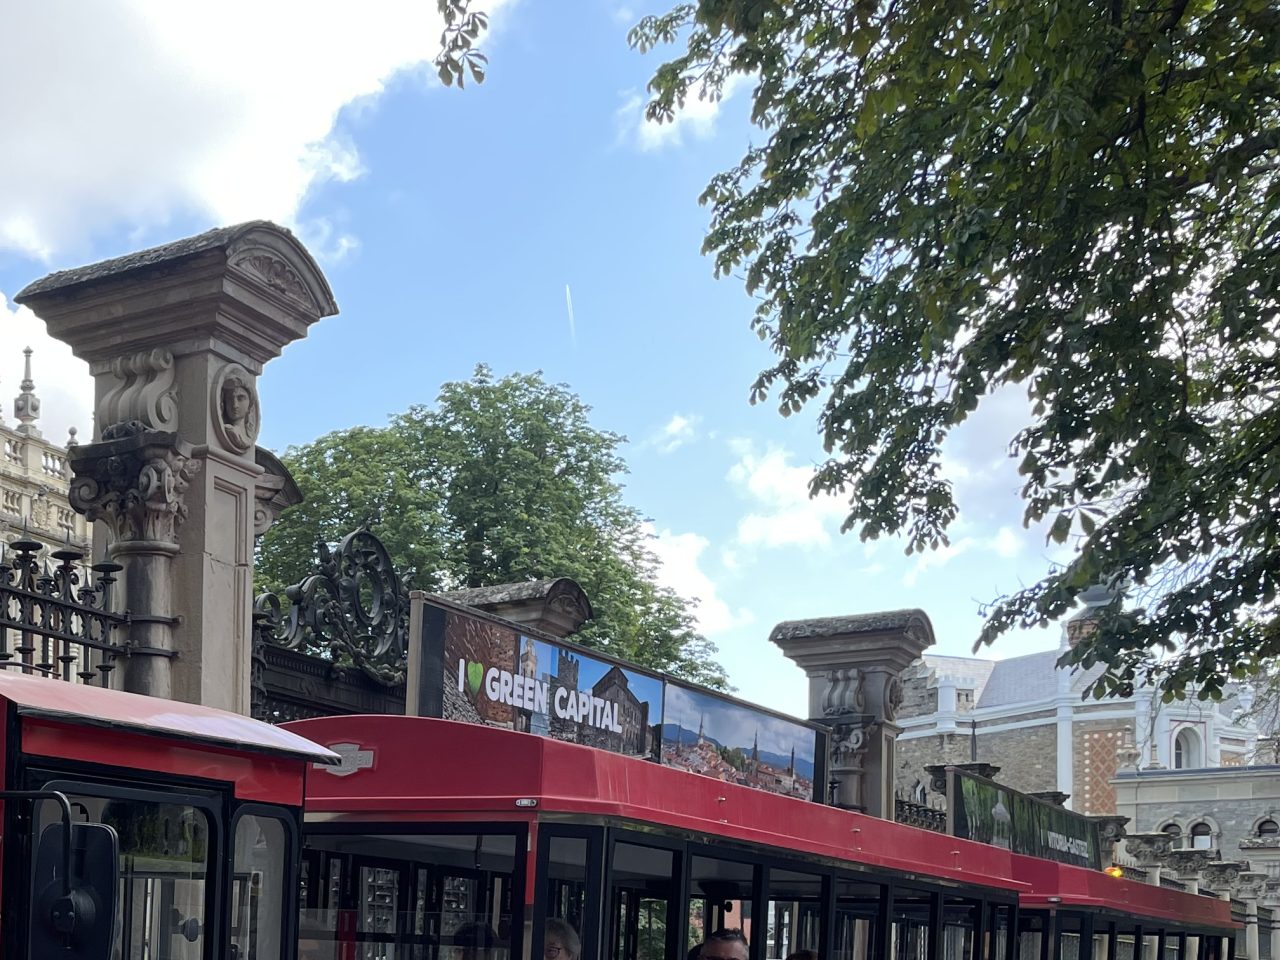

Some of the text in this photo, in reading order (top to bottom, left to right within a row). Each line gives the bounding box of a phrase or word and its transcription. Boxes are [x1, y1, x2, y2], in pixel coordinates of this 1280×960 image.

[458, 658, 623, 734] I GREEN CAPITAL
